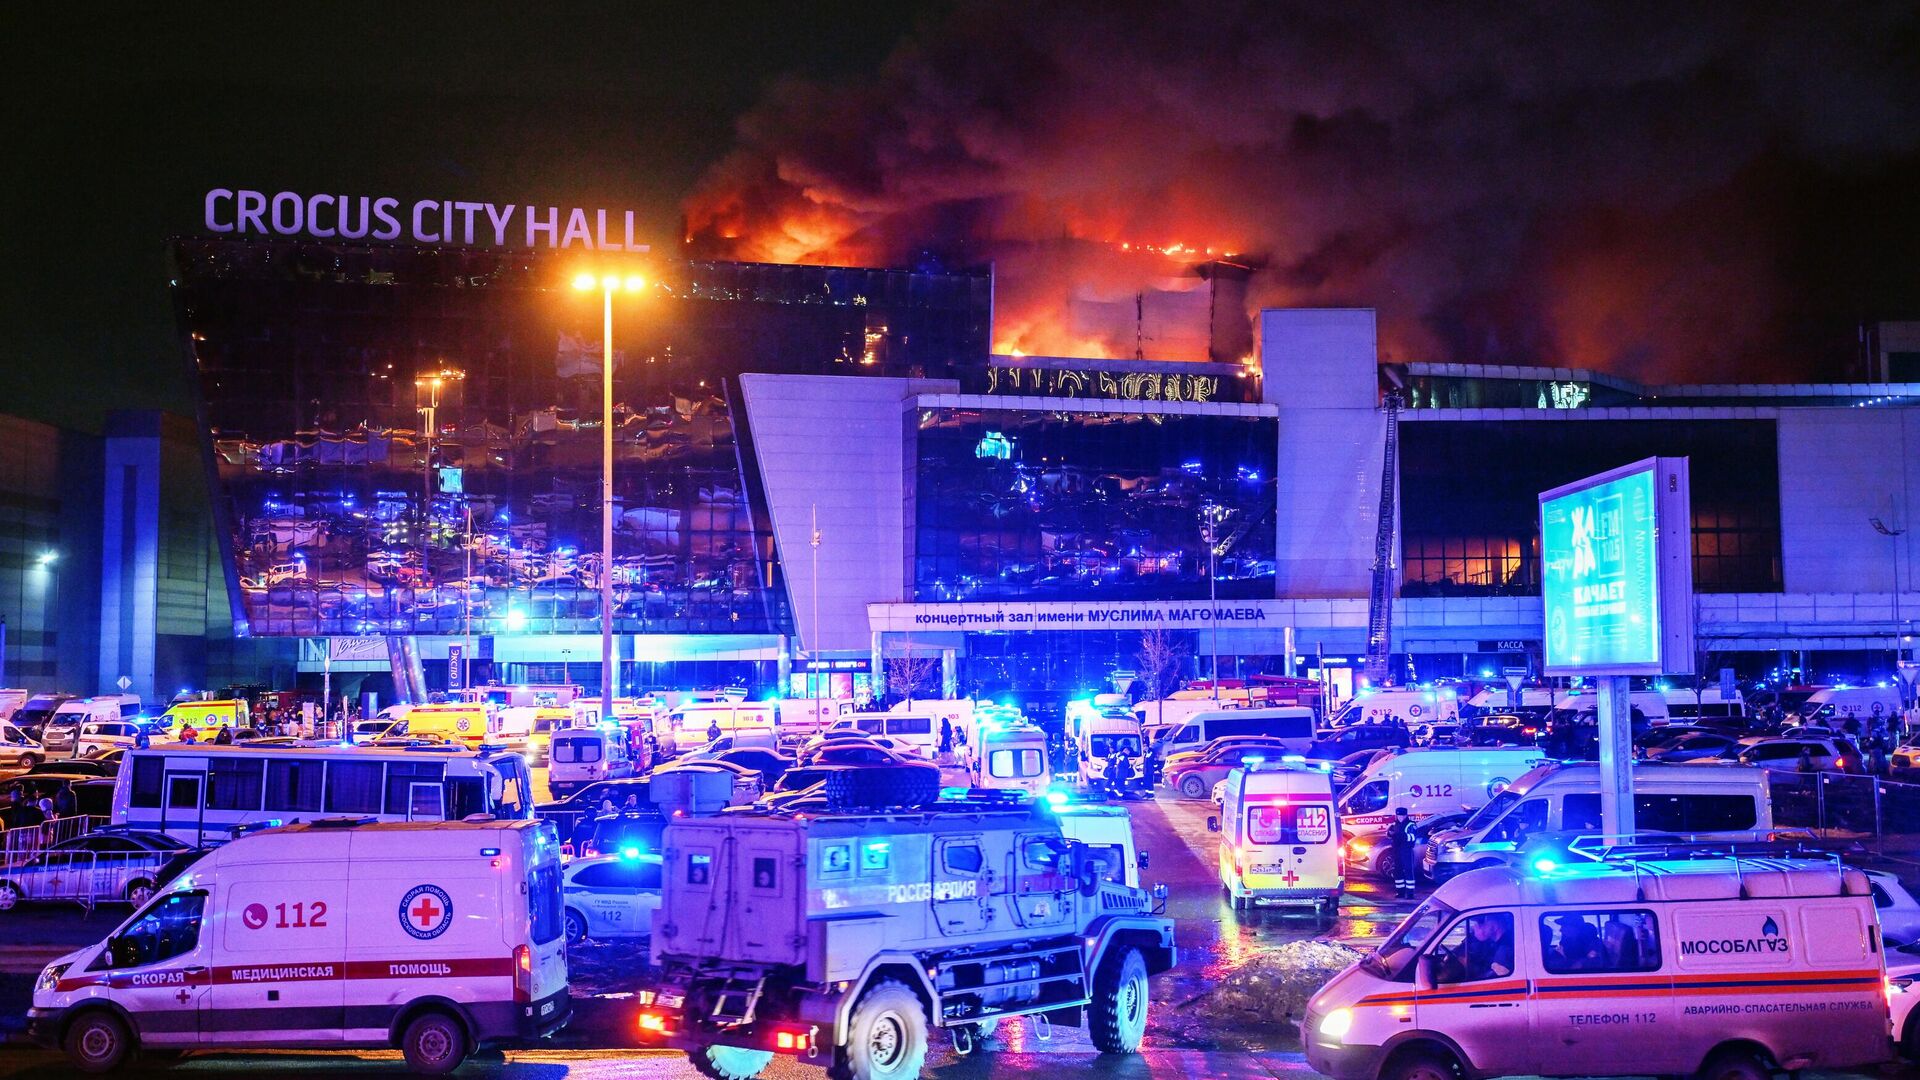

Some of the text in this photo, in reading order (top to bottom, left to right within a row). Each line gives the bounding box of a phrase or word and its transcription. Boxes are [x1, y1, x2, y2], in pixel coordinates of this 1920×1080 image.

[204, 187, 651, 253] CROCUS CITY HALL
[1574, 581, 1626, 604] КАЧАЕТ
[915, 608, 1265, 625] концертный зал имени МУСЛИМА МАГОМАЕВА
[1497, 641, 1524, 649] КАССА
[1379, 708, 1392, 716] 112
[1425, 784, 1453, 797] 112
[1297, 813, 1326, 829] 112
[402, 886, 449, 907] СКОРАЯ ПОМОЩЬ
[887, 880, 976, 903] РОСГВАРДИЯ
[275, 901, 327, 928] 112
[601, 910, 622, 921] 112
[401, 912, 452, 938] МОСКОВСКАЯ ОБЛАСТЬ
[132, 963, 451, 985] СКОРАЯ МЕДИЦИНСКАЯ ПОМОЩЬ
[1684, 1000, 1873, 1015] АВАРИЙНО-СПАСАТЕЛЬНАЯ СЛУЖБА
[1569, 1013, 1656, 1025] ТЕЛЕФОН 112
